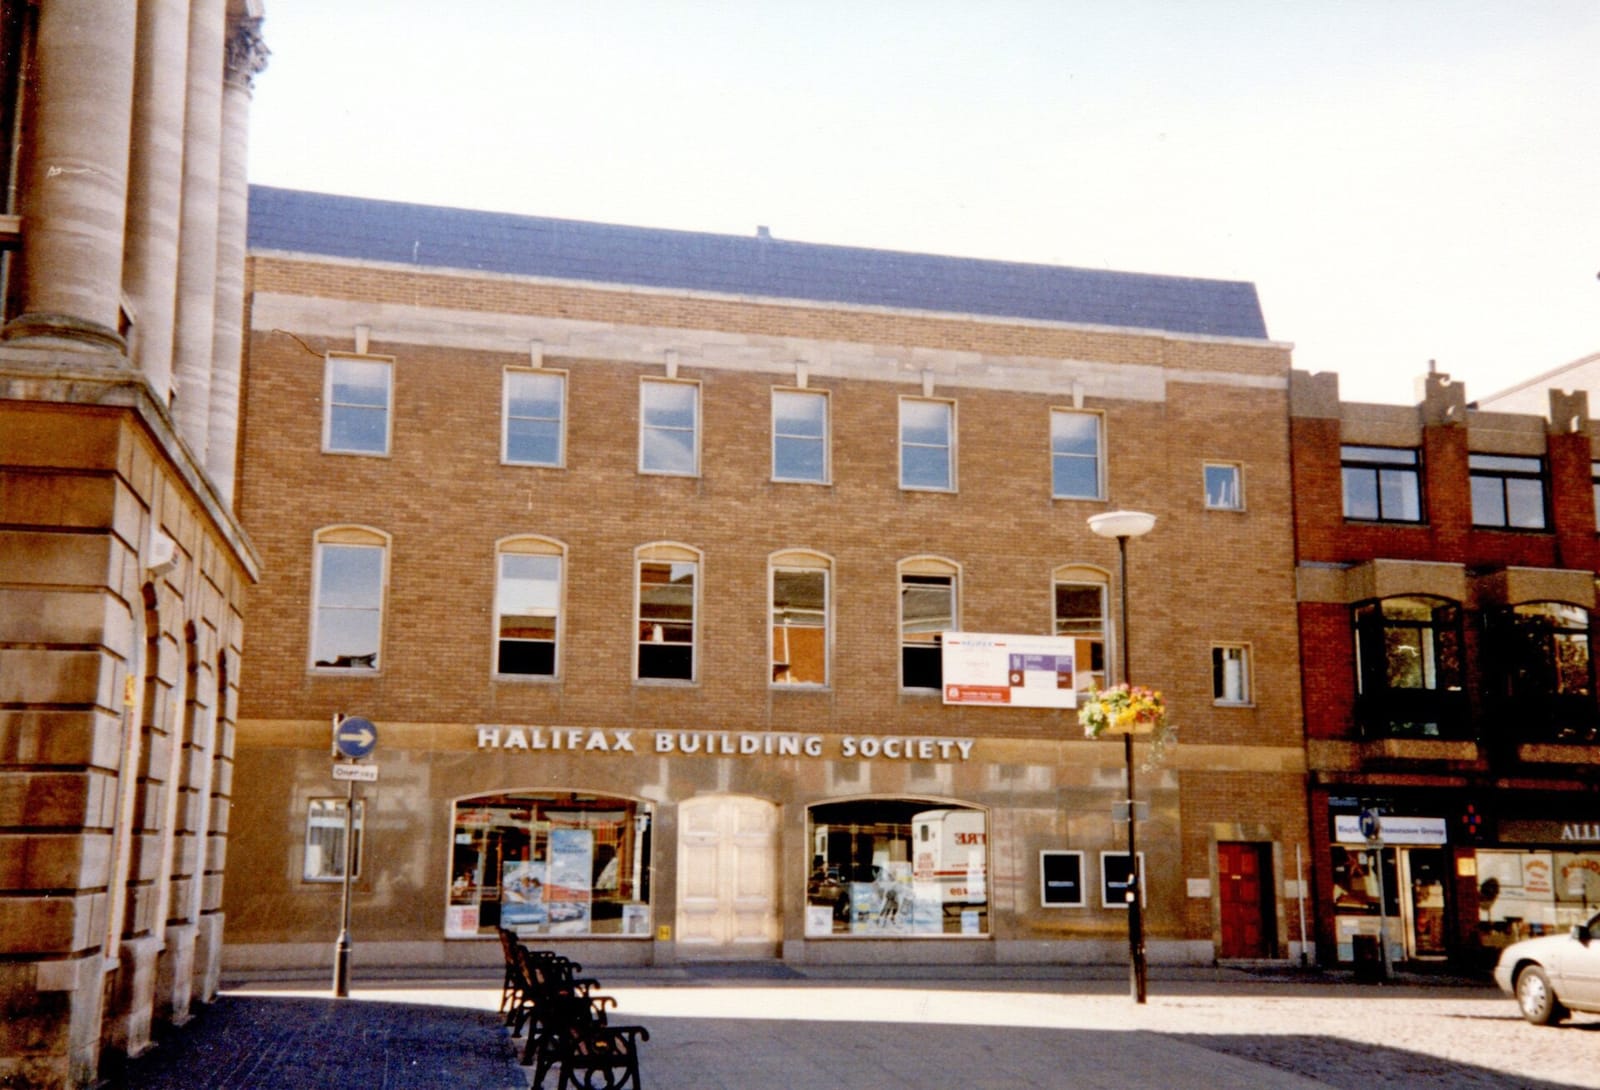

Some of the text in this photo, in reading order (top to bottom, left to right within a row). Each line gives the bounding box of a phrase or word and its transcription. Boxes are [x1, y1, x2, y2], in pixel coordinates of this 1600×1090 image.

[478, 726, 976, 760] HALIFAX BUILDING SOCIETY
